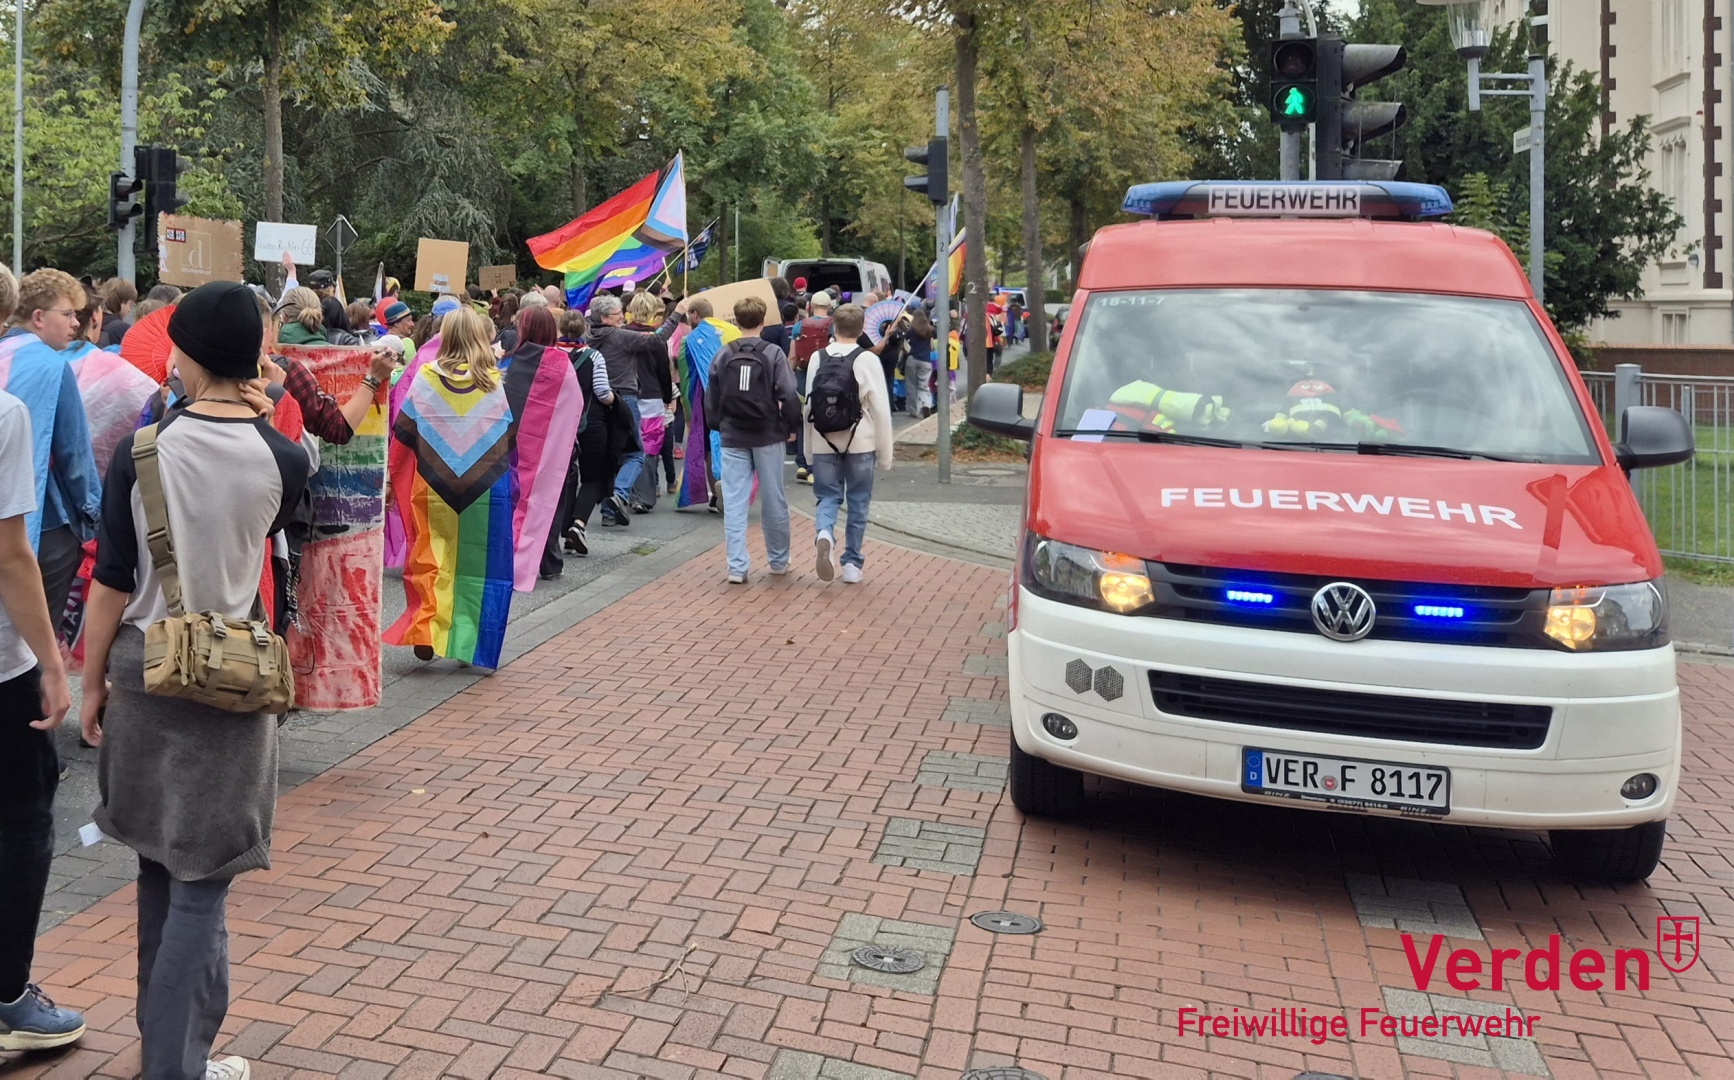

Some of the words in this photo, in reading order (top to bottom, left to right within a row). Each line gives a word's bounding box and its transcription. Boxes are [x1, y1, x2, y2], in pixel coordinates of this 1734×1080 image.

[1211, 187, 1358, 210] FEUERWEHR
[967, 281, 977, 294] 2
[1099, 296, 1167, 307] 18-11-7
[1160, 486, 1524, 531] FEUERWEHR
[1249, 771, 1258, 781] D
[1265, 756, 1319, 789] VER
[1340, 765, 1358, 792] F
[1370, 767, 1443, 801] 8117
